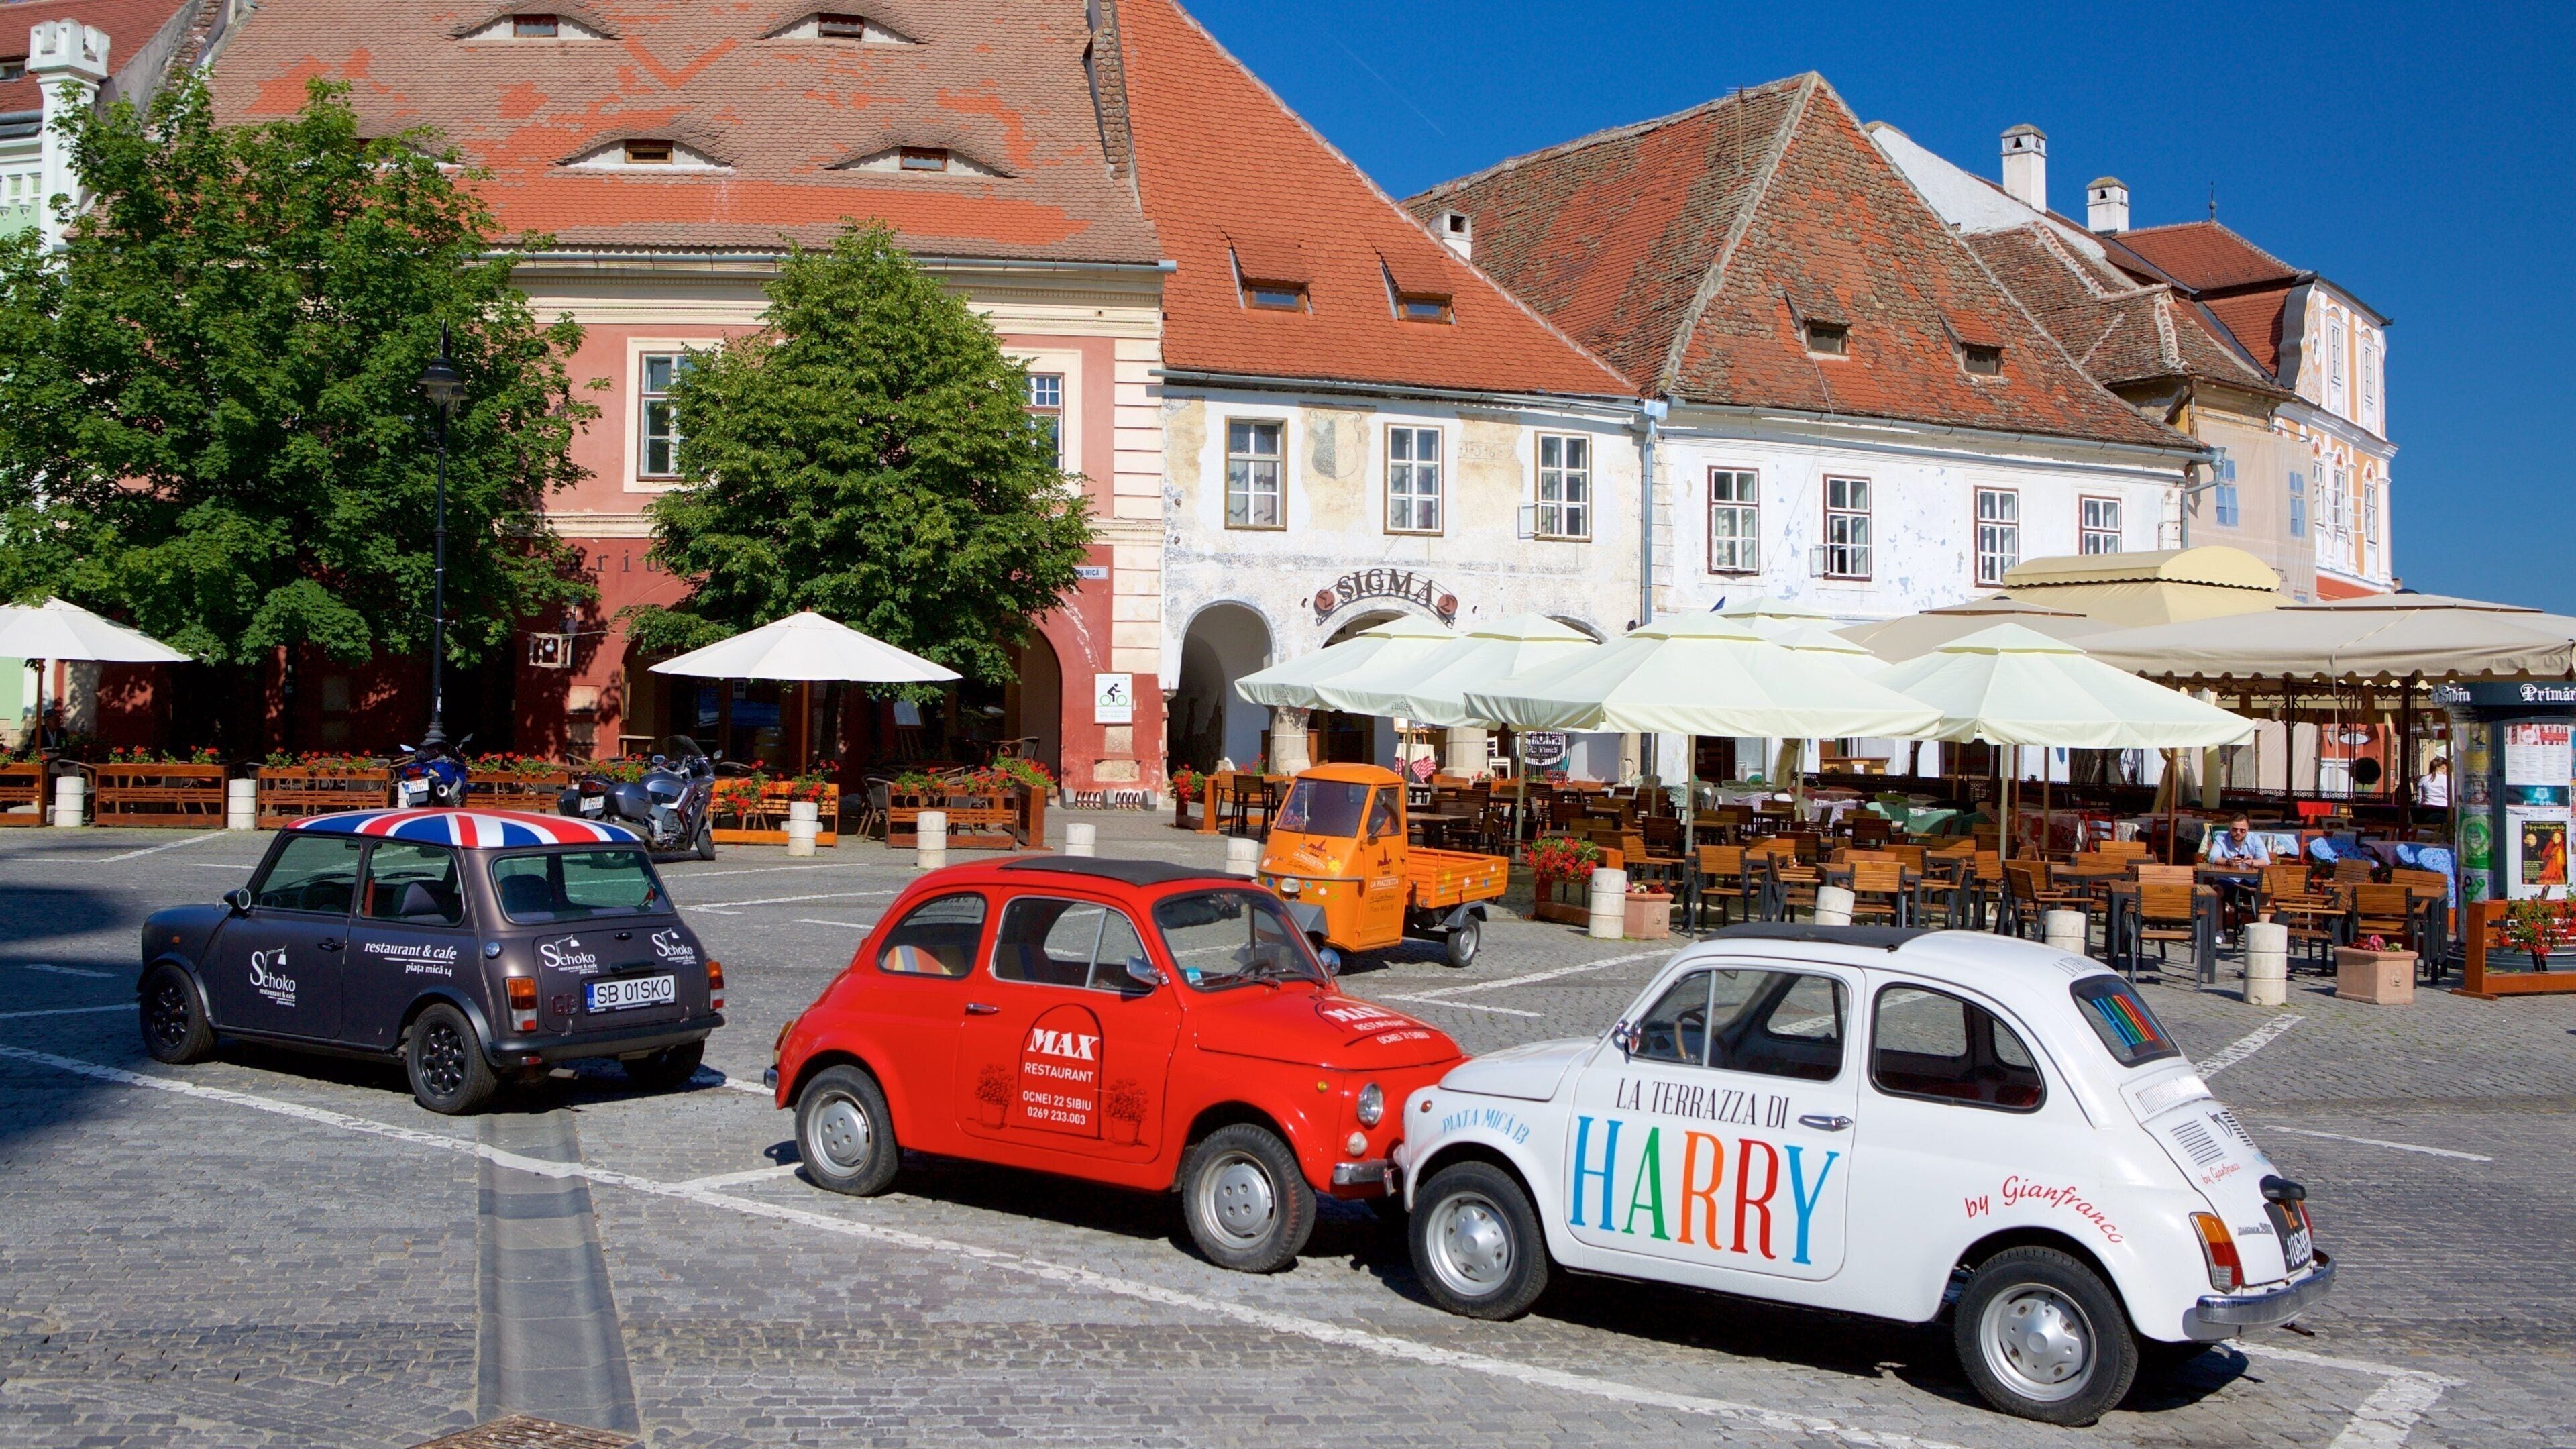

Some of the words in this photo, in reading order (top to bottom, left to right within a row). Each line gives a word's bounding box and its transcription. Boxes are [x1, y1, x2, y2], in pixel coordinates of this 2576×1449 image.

[1336, 569, 1433, 603] SIGMA
[364, 943, 421, 956] restaurant
[422, 944, 431, 957] &
[433, 946, 458, 959] cafe
[540, 944, 596, 967] Schoko
[652, 934, 693, 957] Schoko
[250, 951, 296, 992] Schoko
[445, 968, 452, 977] 14
[597, 985, 619, 1004] SB
[1027, 1028, 1100, 1061] MAX
[1024, 1062, 1093, 1083] RESTAURANT
[1023, 1091, 1051, 1105] OCNEI
[1053, 1095, 1065, 1107] 22
[1066, 1097, 1092, 1111] SIBIU
[1616, 1077, 1640, 1111] LA
[1652, 1081, 1756, 1126] TERRAZZA
[1765, 1095, 1791, 1129] DI
[1027, 1106, 1048, 1119] 0269
[1051, 1110, 1086, 1125] 233.003
[1512, 1124, 1529, 1144] 13
[1569, 1115, 1839, 1265] HARRY
[1965, 1195, 1989, 1219] by
[2002, 1175, 2125, 1244] Gianfranco
